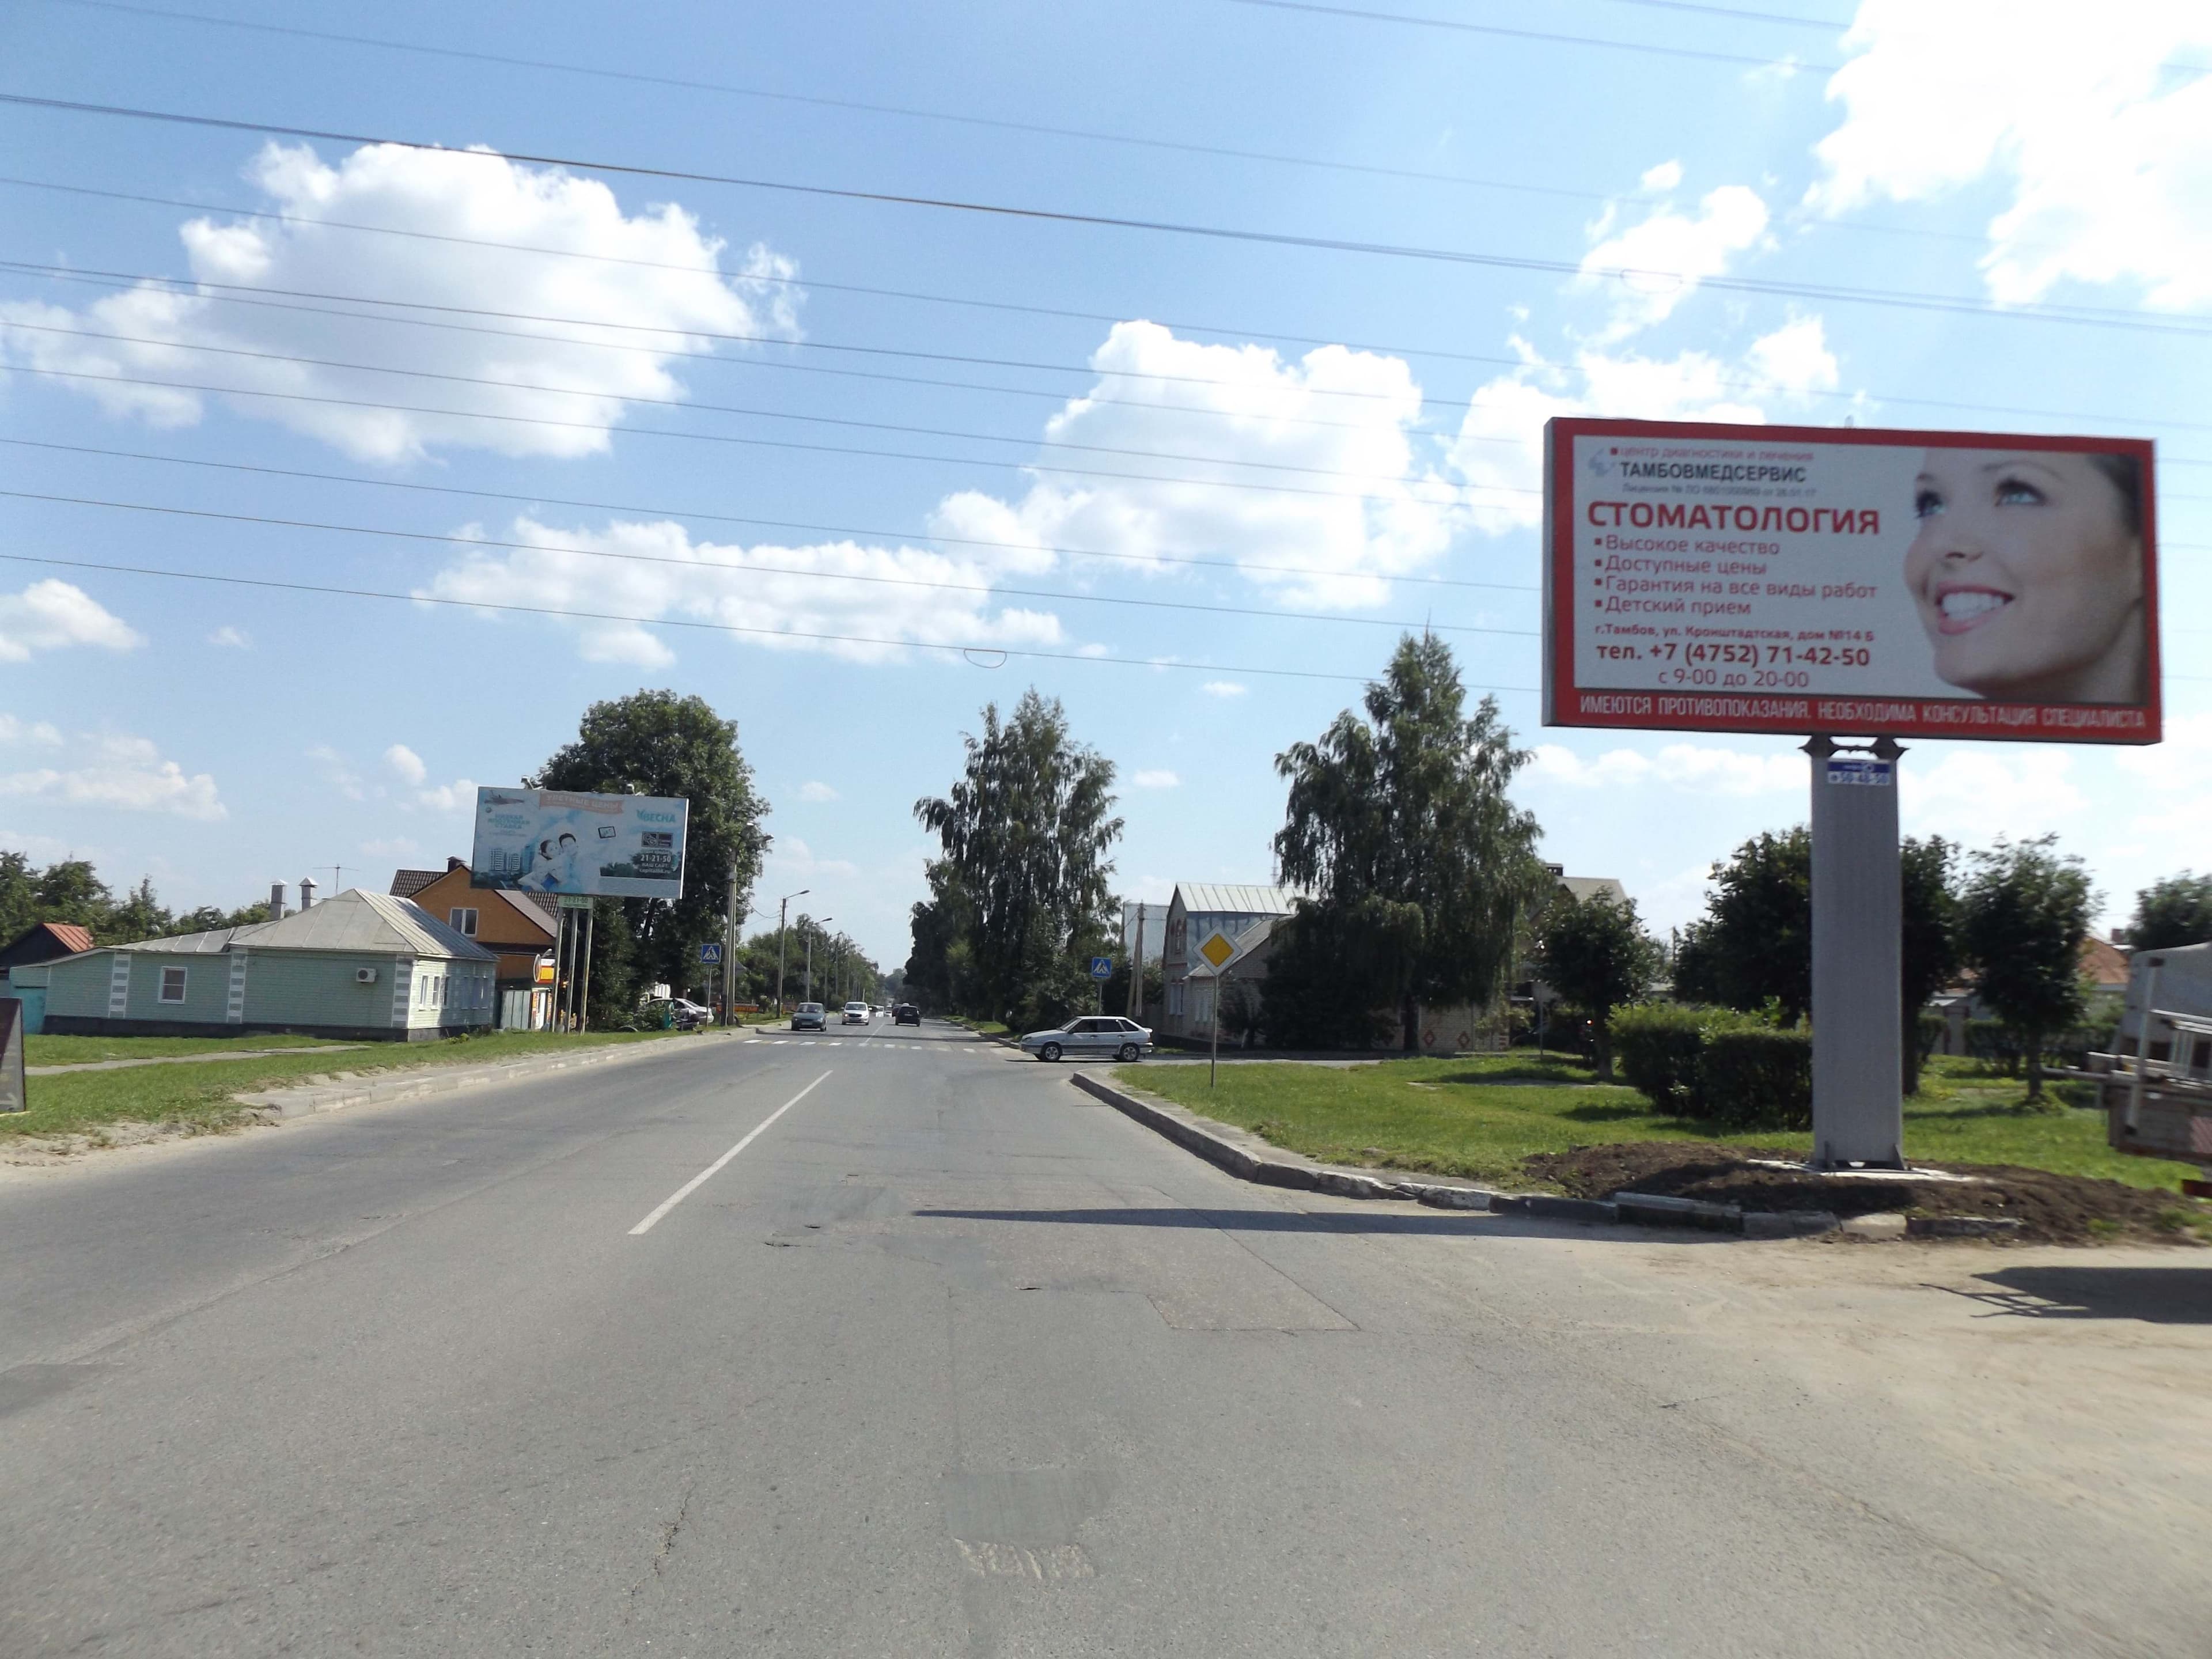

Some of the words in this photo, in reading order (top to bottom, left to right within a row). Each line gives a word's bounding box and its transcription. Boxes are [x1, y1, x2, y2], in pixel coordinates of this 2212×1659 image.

[1621, 461, 1806, 483] ТАМБОВМЕДСЕРВИС
[1588, 501, 1880, 535] СТОМАТОЛОГИЯ
[1606, 535, 1688, 553] Высокое
[1695, 540, 1780, 555] качество
[1605, 555, 1711, 575] Доступные
[1718, 561, 1767, 576] цены
[1606, 576, 1694, 594] Гарантия
[1701, 581, 1722, 594] на
[1729, 582, 1760, 595] все
[1767, 583, 1815, 598] виды
[1822, 582, 1876, 600] работ
[1605, 596, 1685, 615] Детский
[1691, 601, 1751, 616] прием
[1797, 632, 1824, 641] дом
[1596, 645, 1642, 660] тел.
[1650, 643, 1677, 660] +7
[1685, 642, 1759, 667] (4752)
[1767, 645, 1870, 666] 71-42-50
[1658, 672, 1668, 684] с
[1674, 668, 1716, 685] 9-00
[1723, 673, 1746, 688] до
[1754, 671, 1809, 688] 20-00
[1580, 694, 1651, 715] ИМЕЮТСЯ
[1659, 696, 1811, 719] ПРОТИВОПОКАЗАНИЯ.
[1818, 702, 1916, 722] НЕОБХОДИМА
[1922, 706, 2037, 725] КОНСУЛЬТАЦИЯ
[2042, 709, 2145, 729] СПЕЦИАЛИСТА
